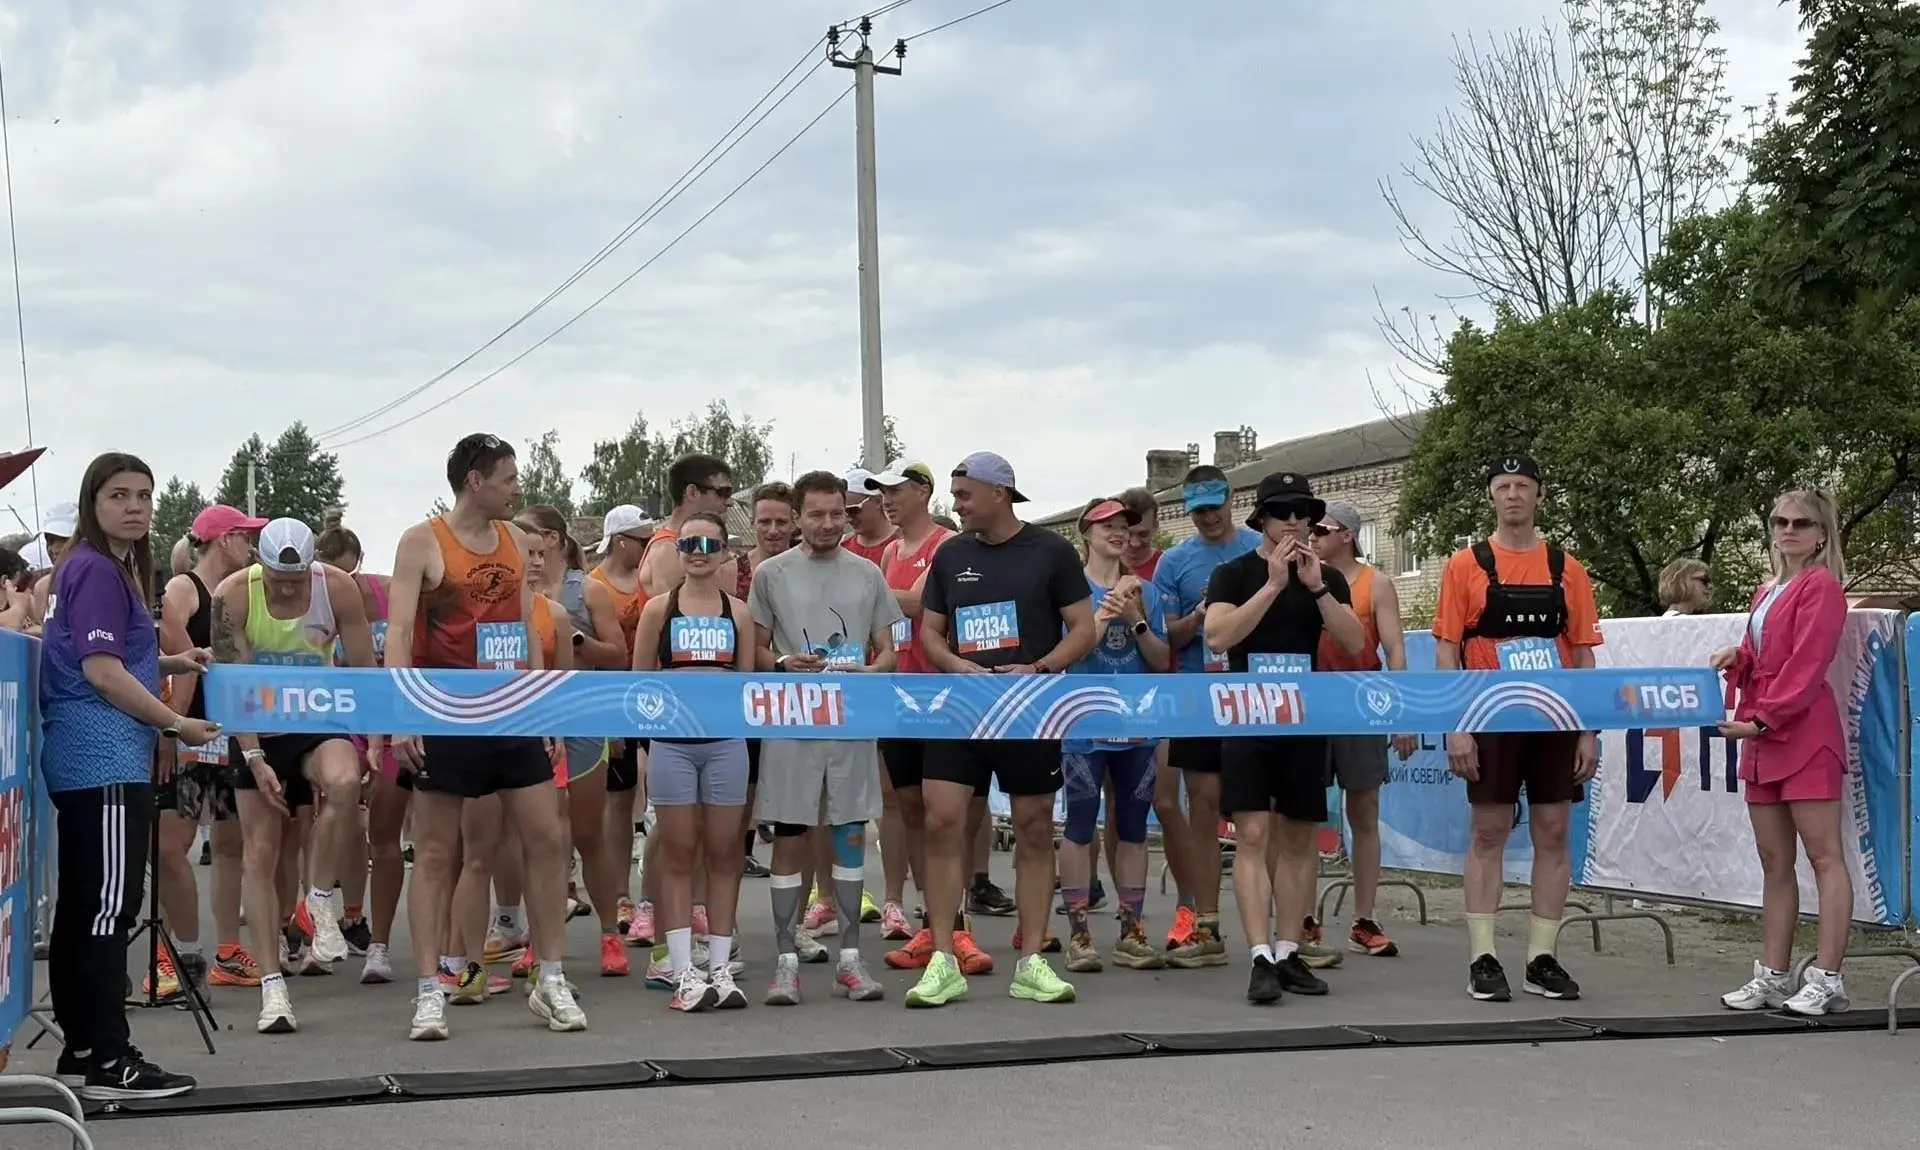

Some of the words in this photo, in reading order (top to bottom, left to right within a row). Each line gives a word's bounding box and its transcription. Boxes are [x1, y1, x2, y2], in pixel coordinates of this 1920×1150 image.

[96, 628, 115, 642] ПСБ
[678, 627, 728, 651] 02106
[964, 614, 1010, 641] 02134
[484, 635, 521, 660] 02127
[1508, 647, 1553, 671] 02121
[282, 687, 357, 713] ПСБ
[742, 681, 842, 727] СТАРТ
[1209, 682, 1303, 727] СТАРТ
[1640, 685, 1700, 710] ПСБ
